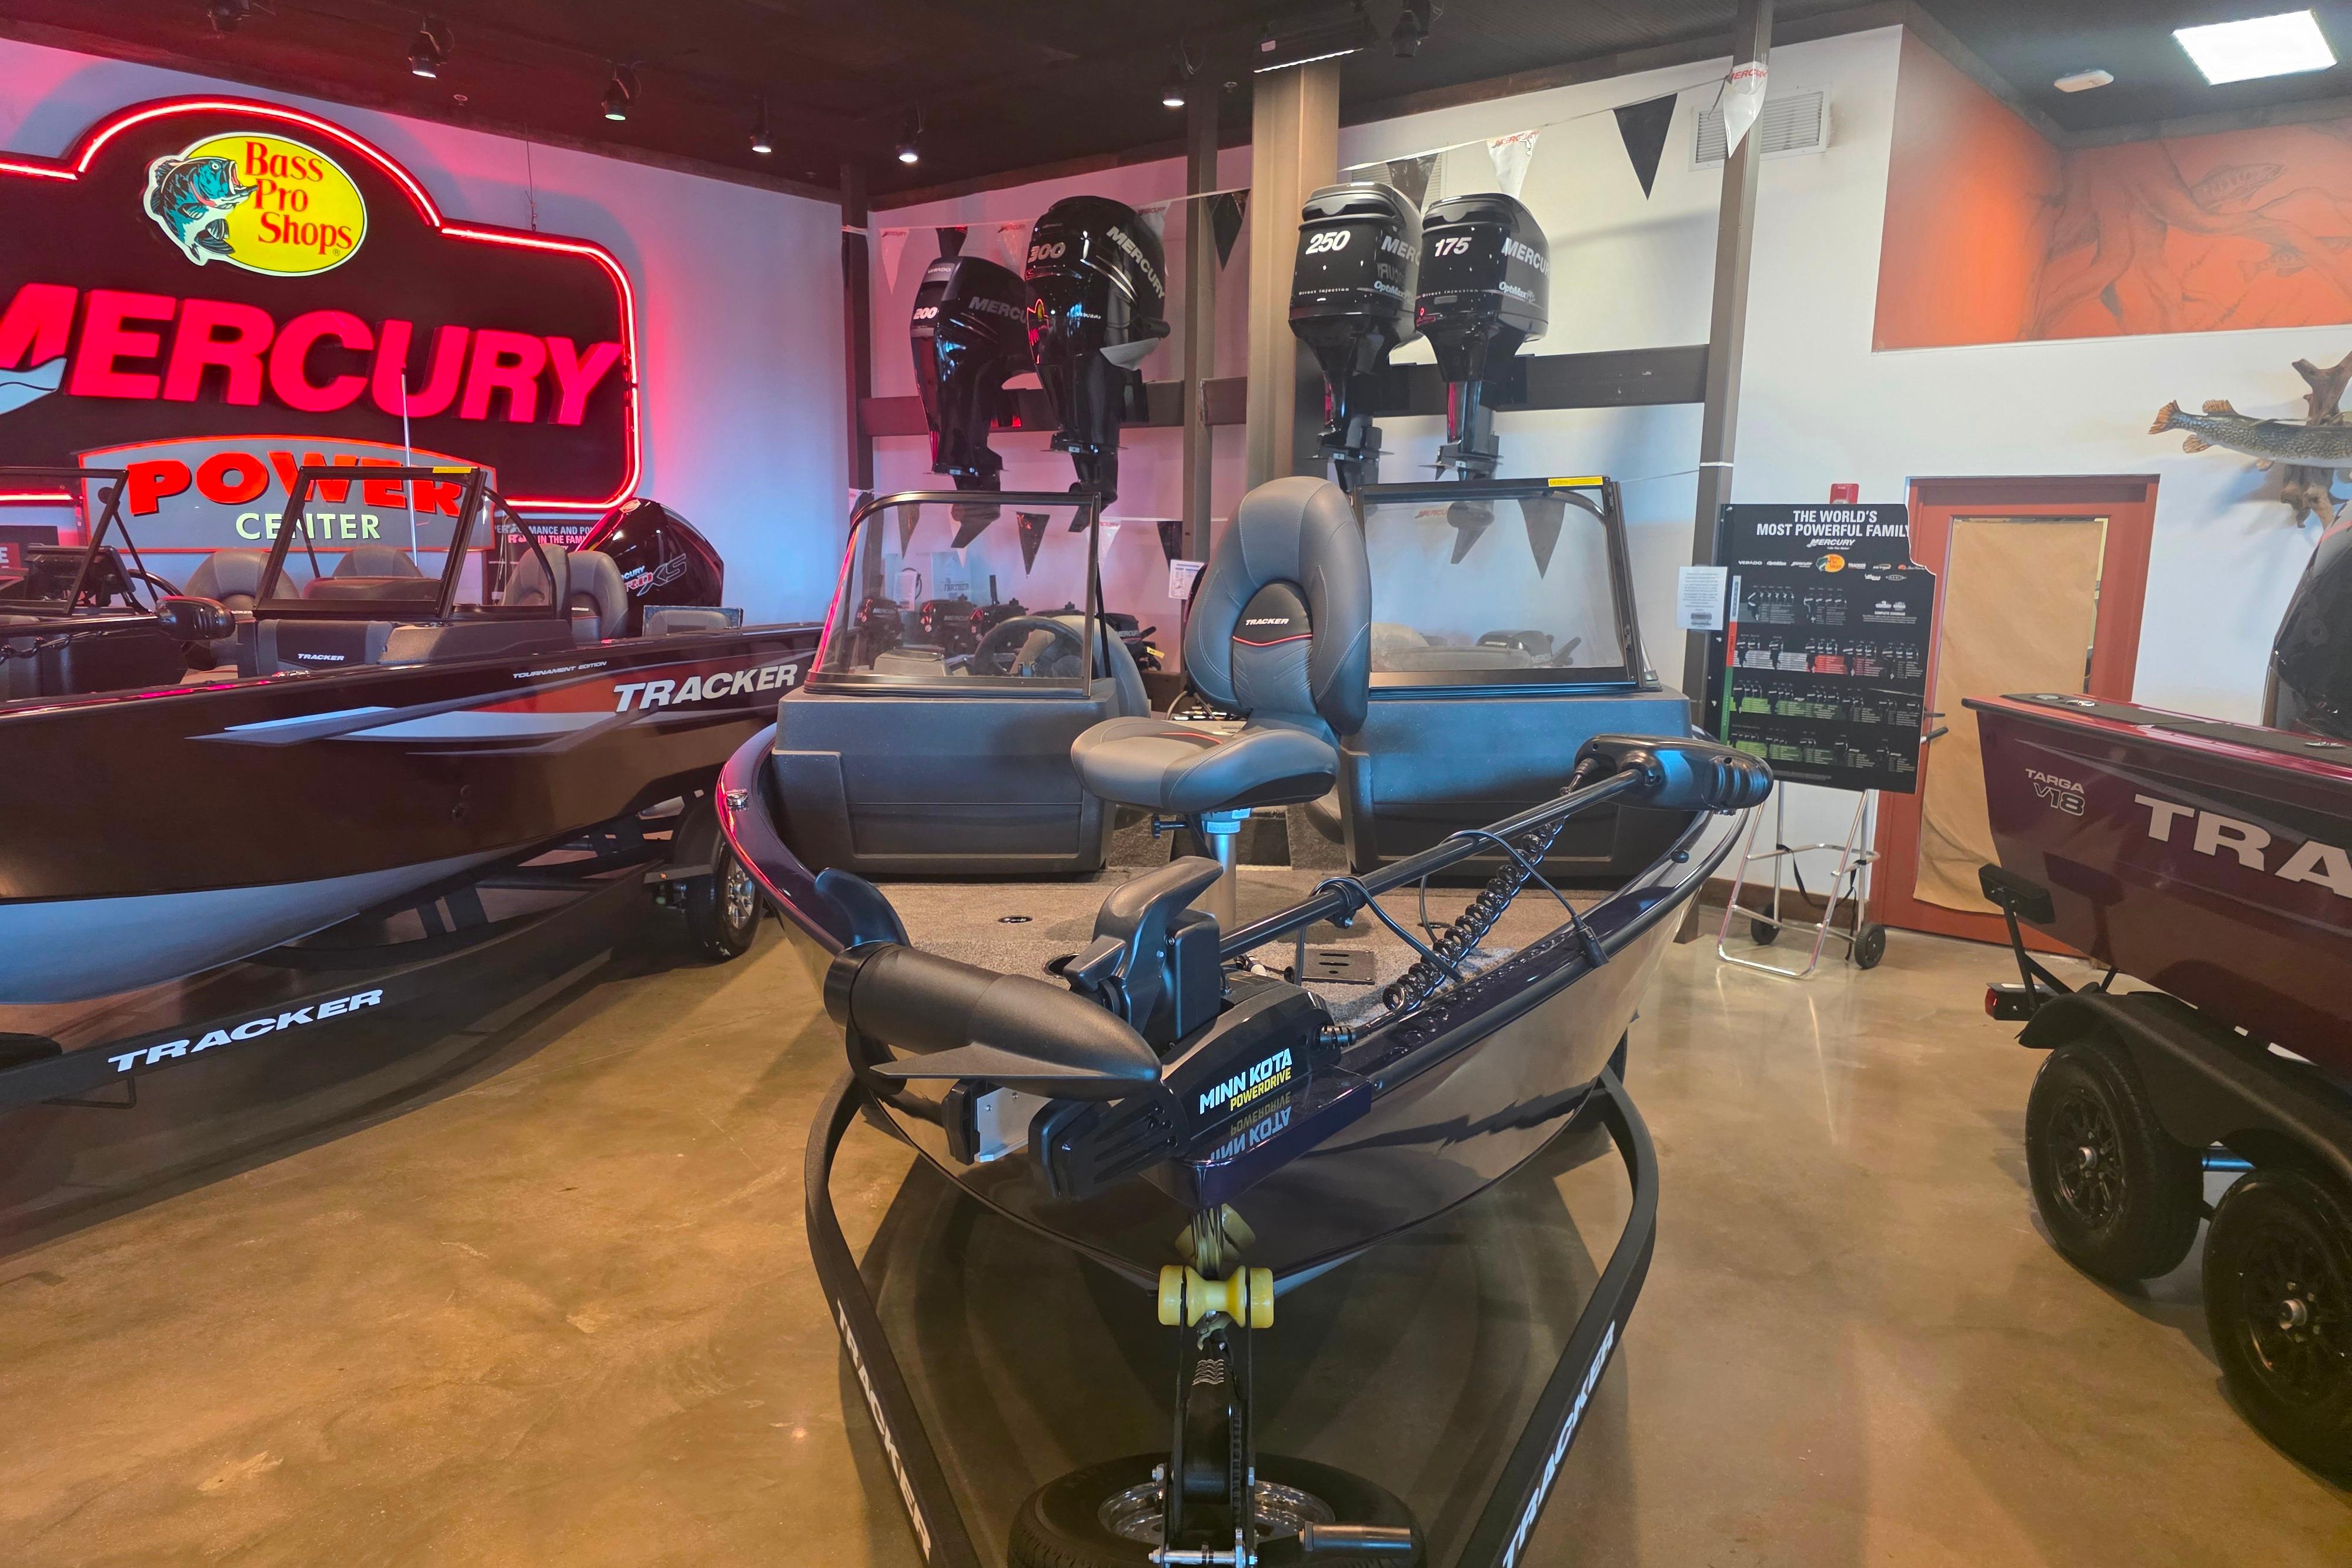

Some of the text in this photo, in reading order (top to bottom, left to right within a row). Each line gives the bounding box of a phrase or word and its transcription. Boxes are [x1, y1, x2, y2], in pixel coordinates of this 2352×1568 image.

[245, 141, 323, 182] Bass
[253, 178, 309, 212] Pro
[258, 211, 353, 255] Shops
[1305, 230, 1351, 255] 250
[1435, 237, 1472, 257] 175
[1028, 242, 1065, 263] 300
[1106, 226, 1165, 299] MERCURY
[1381, 235, 1421, 266] MERC
[1501, 237, 1550, 279] MERCUR
[913, 306, 938, 320] 200
[968, 296, 1027, 324] MERCU
[0, 283, 624, 426] MERCURY
[127, 452, 461, 516] POWER
[560, 526, 577, 534] AND
[1756, 523, 1792, 536] MOST
[1795, 524, 1862, 537] POWERFUL
[1793, 510, 1877, 523] THE WORLD'S
[537, 536, 547, 544] IN
[549, 536, 564, 544] THE
[566, 536, 585, 544] FAM
[1809, 539, 1856, 547] MERCURY
[513, 661, 607, 678] TOURNAMENT EDITION
[613, 664, 797, 713] TRACKER
[2025, 768, 2084, 794] TARGA
[2033, 782, 2085, 816] V18
[108, 989, 383, 1072] TRACKER
[1200, 1048, 1292, 1115] MINN KOTA
[1230, 1066, 1291, 1111] POWERDRIVE
[837, 1298, 932, 1564] TRACKER
[1502, 1320, 1616, 1568] TRACKER
